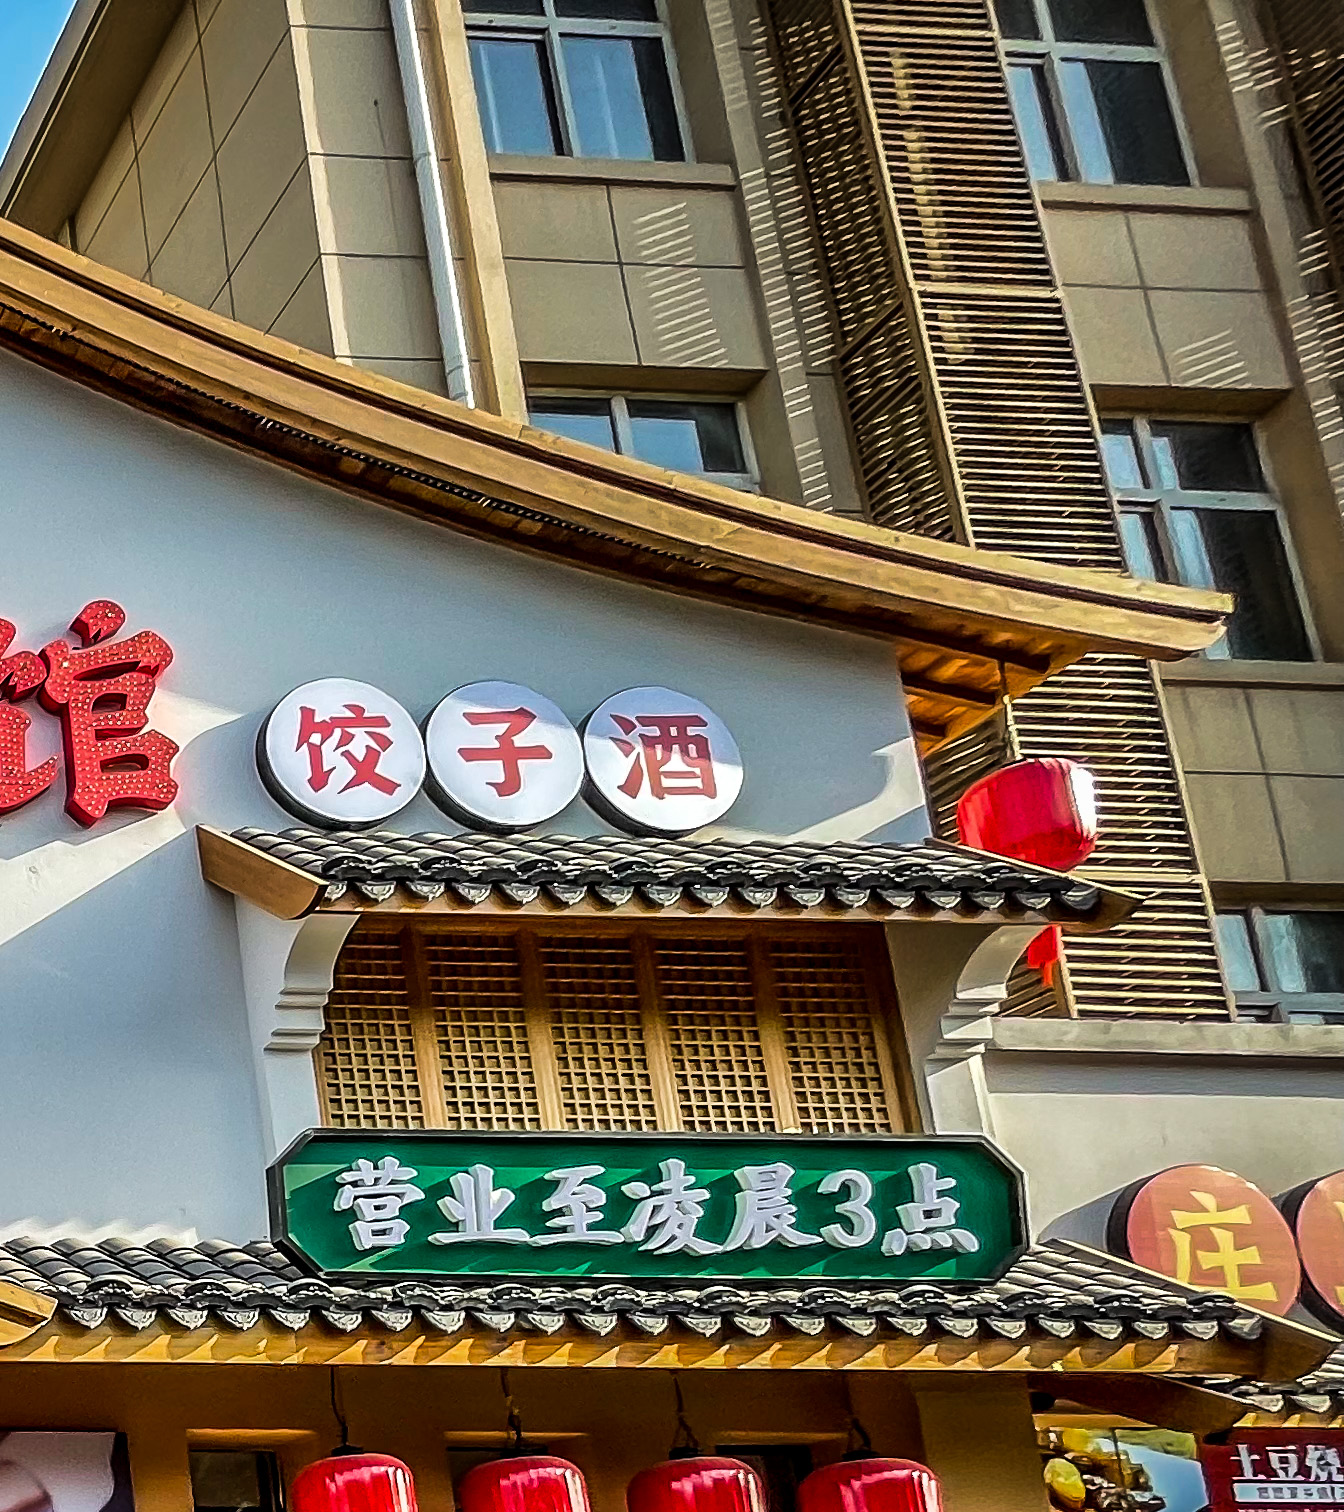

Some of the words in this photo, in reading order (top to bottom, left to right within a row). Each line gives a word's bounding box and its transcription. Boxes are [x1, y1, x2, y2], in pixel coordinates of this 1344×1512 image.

[295, 702, 718, 800] 饺子酒
[333, 1155, 983, 1258] 营业至凌晨3点
[1168, 1190, 1344, 1303] 庄
